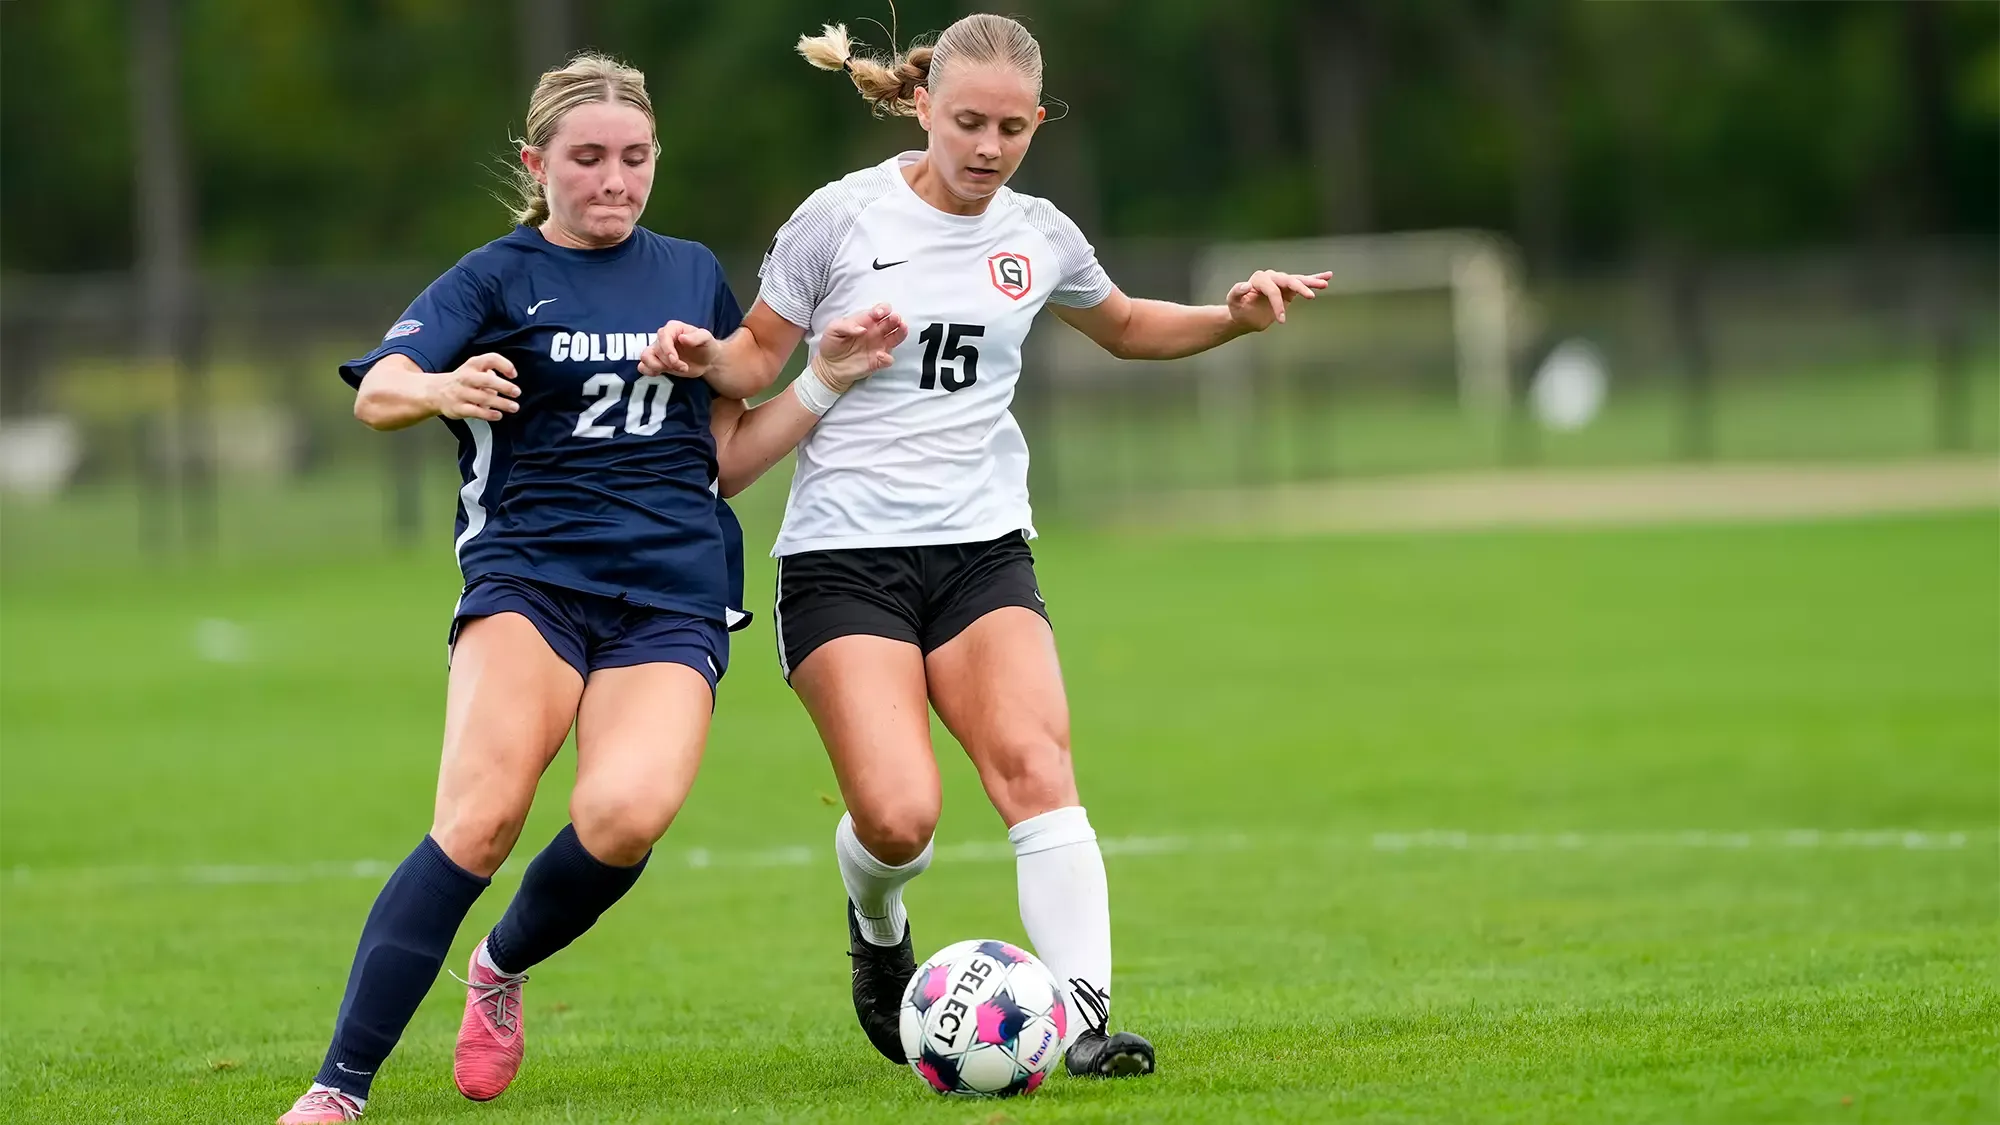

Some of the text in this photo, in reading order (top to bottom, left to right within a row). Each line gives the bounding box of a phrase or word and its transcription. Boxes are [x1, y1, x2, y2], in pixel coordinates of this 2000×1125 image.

[999, 257, 1023, 289] G
[550, 331, 658, 362] COLUM
[919, 323, 986, 393] 15
[571, 372, 674, 439] 20
[934, 959, 992, 1048] SELECT
